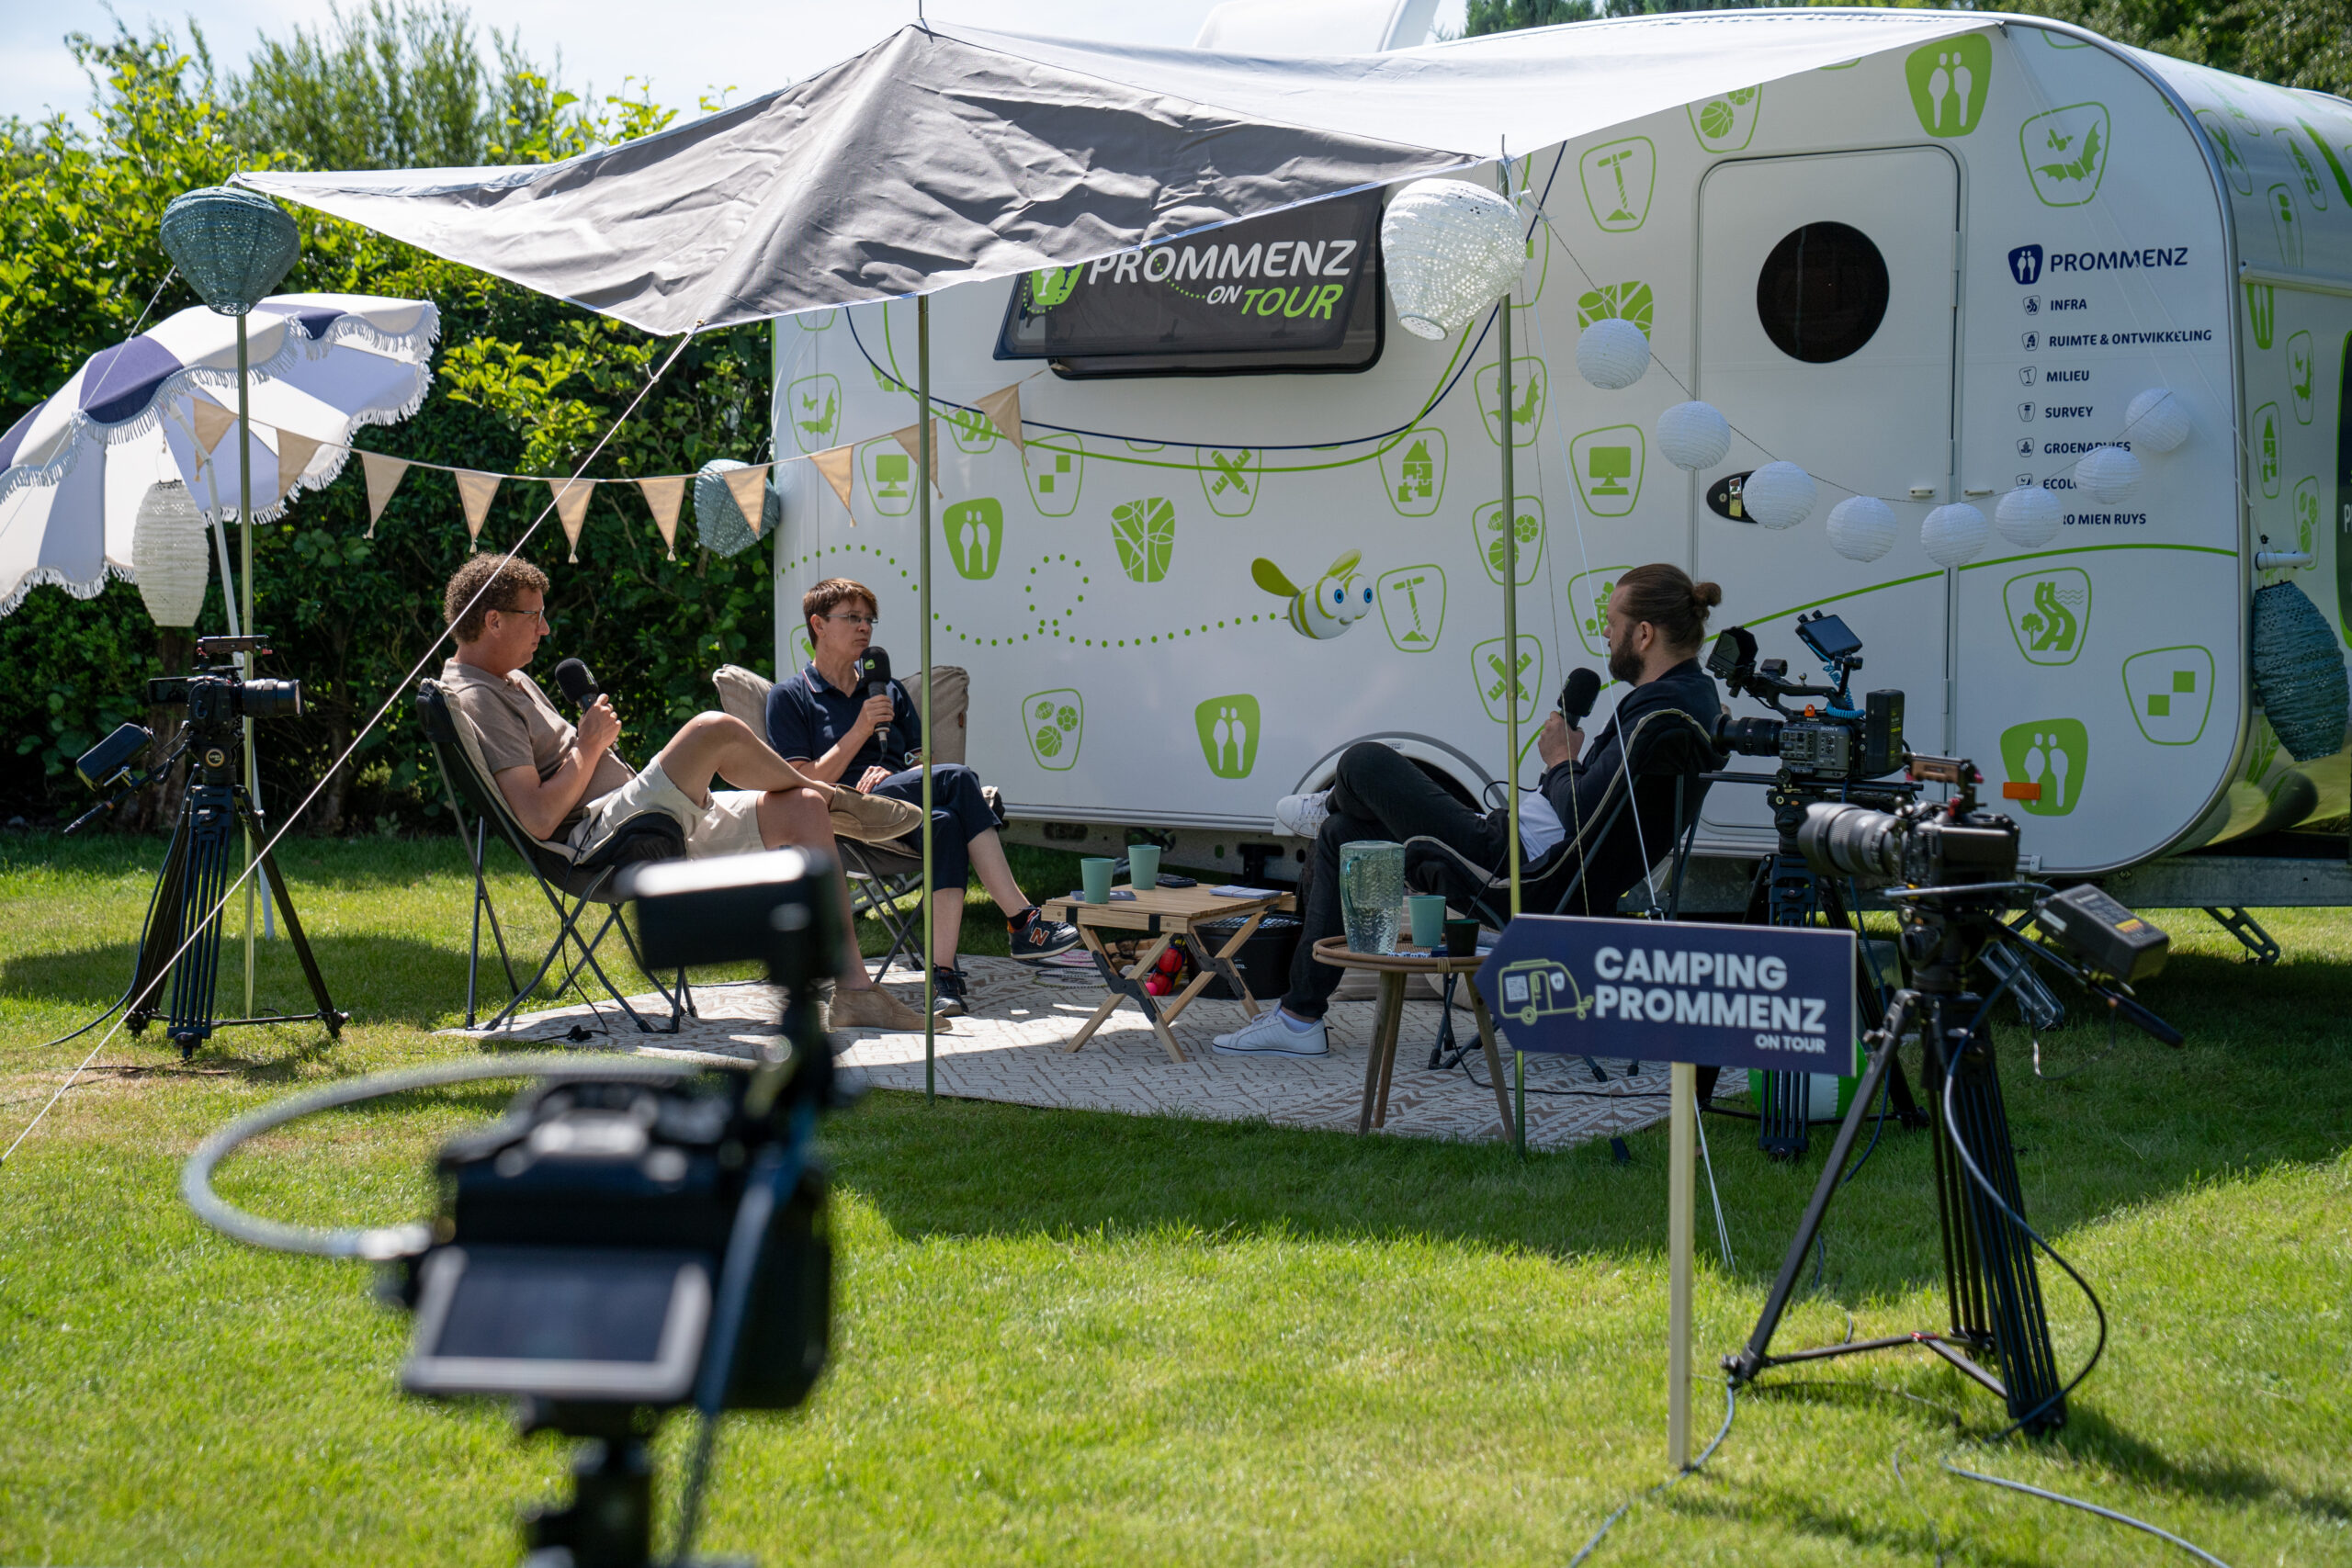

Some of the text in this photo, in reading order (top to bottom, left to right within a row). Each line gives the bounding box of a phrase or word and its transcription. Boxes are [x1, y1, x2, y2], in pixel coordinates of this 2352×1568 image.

[1088, 240, 1357, 285] PROMMENZ
[2050, 246, 2188, 273] PROMMENZ
[1206, 284, 1344, 320] ON TOUR
[2050, 299, 2087, 311] INFRA
[2049, 329, 2212, 347] RUIMTE & ONTWIKKELING
[2046, 369, 2090, 382] MILIEU
[2045, 406, 2094, 419] SURVEY
[2077, 513, 2111, 525] MIEN
[2113, 513, 2147, 525] RUYS
[1029, 927, 1049, 946] N
[1594, 946, 1788, 992] CAMPING
[1595, 984, 1826, 1034] PROMMENZ
[1755, 1033, 1826, 1054] ON TOUR
